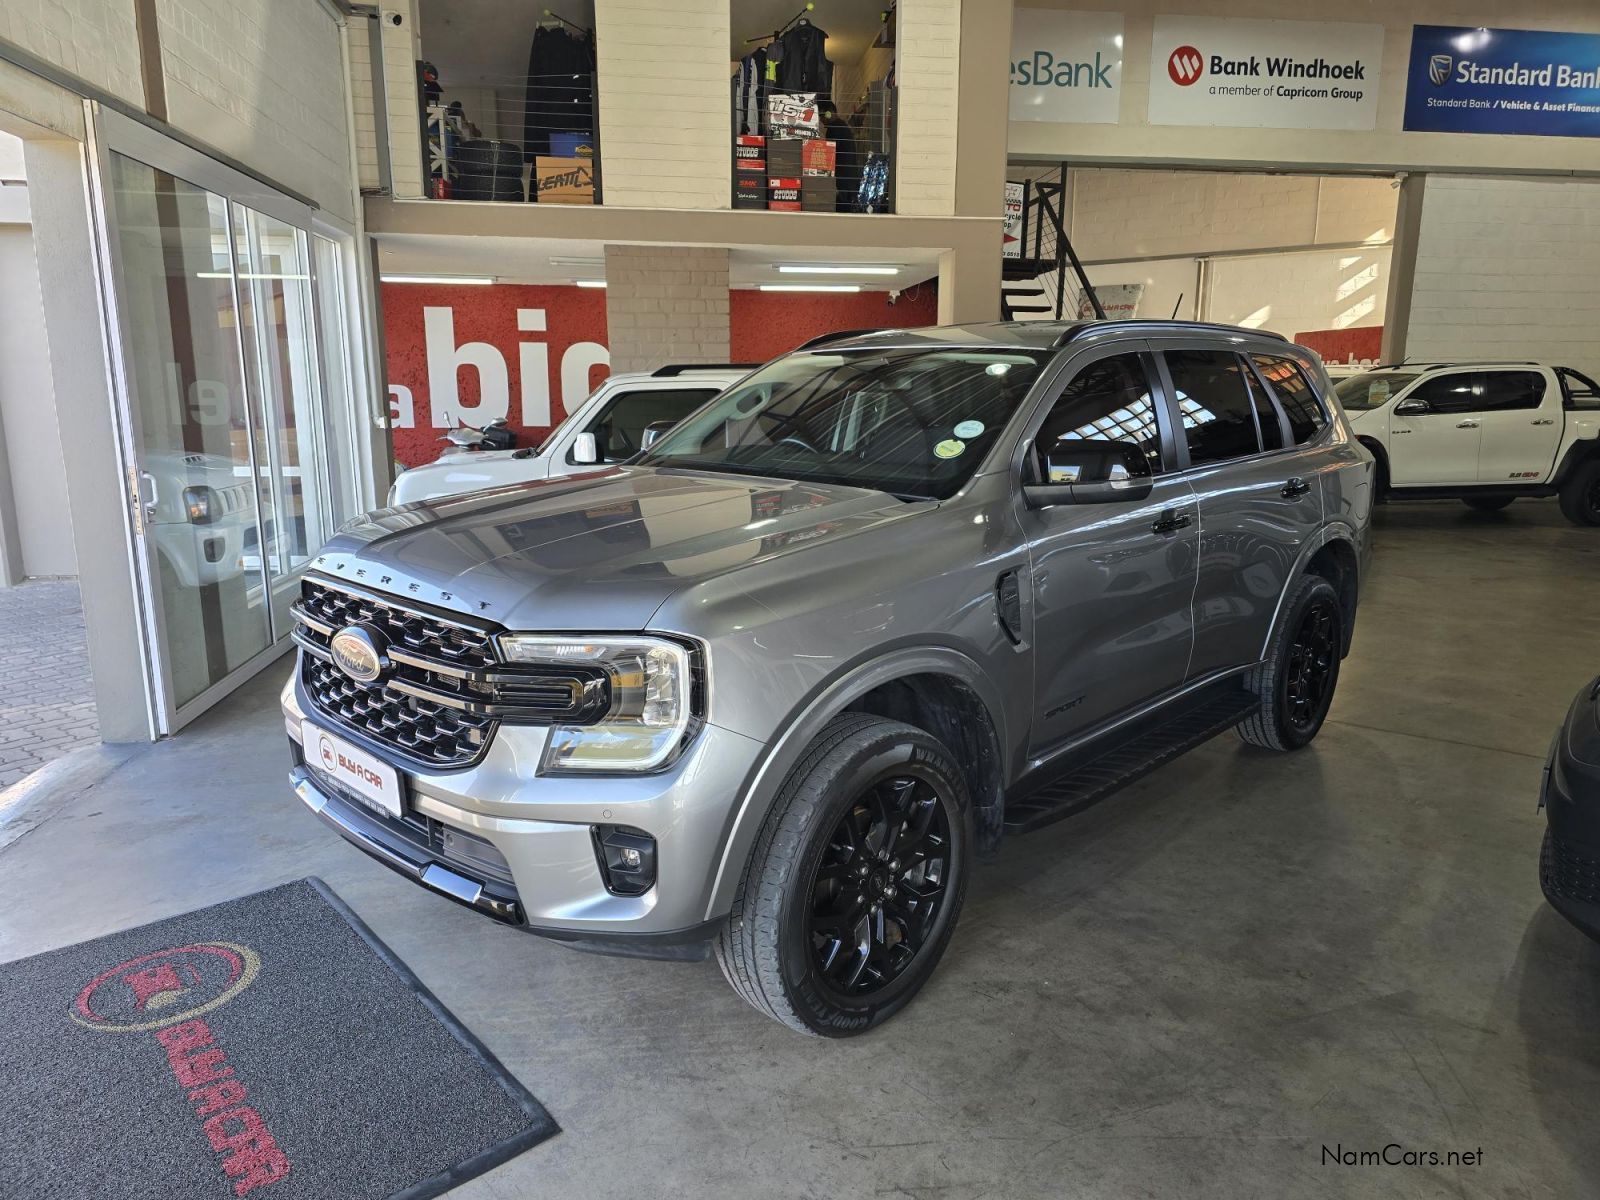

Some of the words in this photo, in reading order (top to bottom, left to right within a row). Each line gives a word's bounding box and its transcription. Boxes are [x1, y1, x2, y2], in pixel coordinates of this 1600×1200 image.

[1209, 55, 1260, 76] Bank
[1266, 56, 1365, 80] Windhoek
[1456, 60, 1553, 87] Standard
[1208, 86, 1216, 96] a
[1218, 84, 1261, 97] member
[1263, 84, 1275, 97] of
[1276, 85, 1328, 100] Capricorn
[1331, 87, 1364, 102] Group
[1427, 97, 1468, 109] Standard
[1469, 99, 1491, 109] Bank
[1500, 100, 1531, 111] Vehicle
[1533, 101, 1541, 111] &
[1542, 101, 1567, 112] Asset
[317, 556, 492, 610] EVEREST
[339, 647, 364, 672] Ford
[338, 753, 356, 774] BUY
[356, 764, 364, 779] A
[364, 768, 383, 791] CAR
